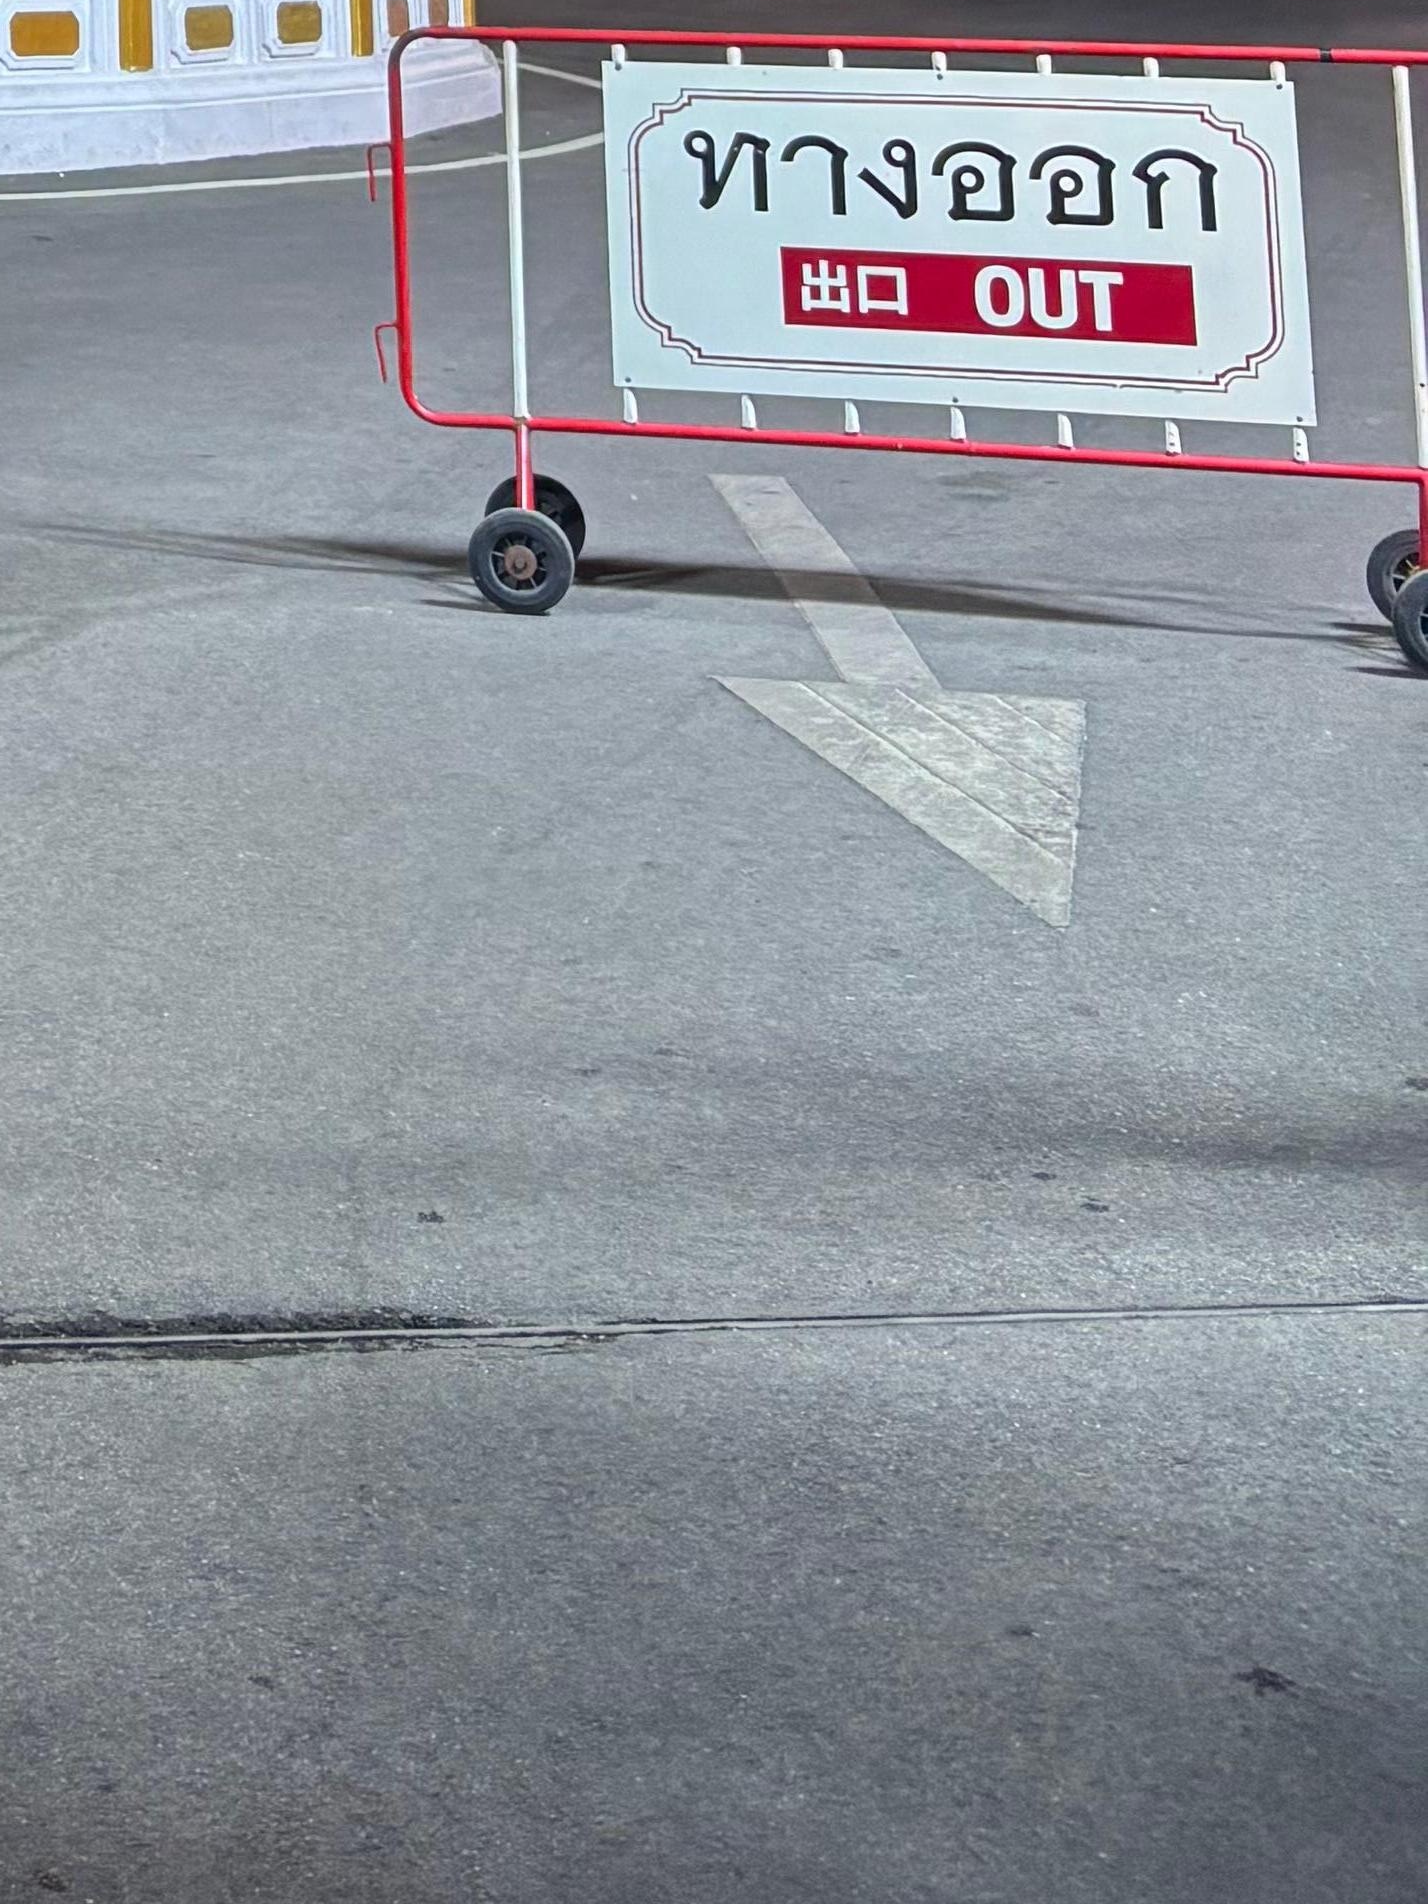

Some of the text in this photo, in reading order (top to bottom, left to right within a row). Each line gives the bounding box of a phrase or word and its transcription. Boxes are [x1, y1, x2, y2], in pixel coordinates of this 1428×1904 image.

[683, 129, 1219, 232] ทางออก
[800, 258, 1125, 332] 出口 OUT
